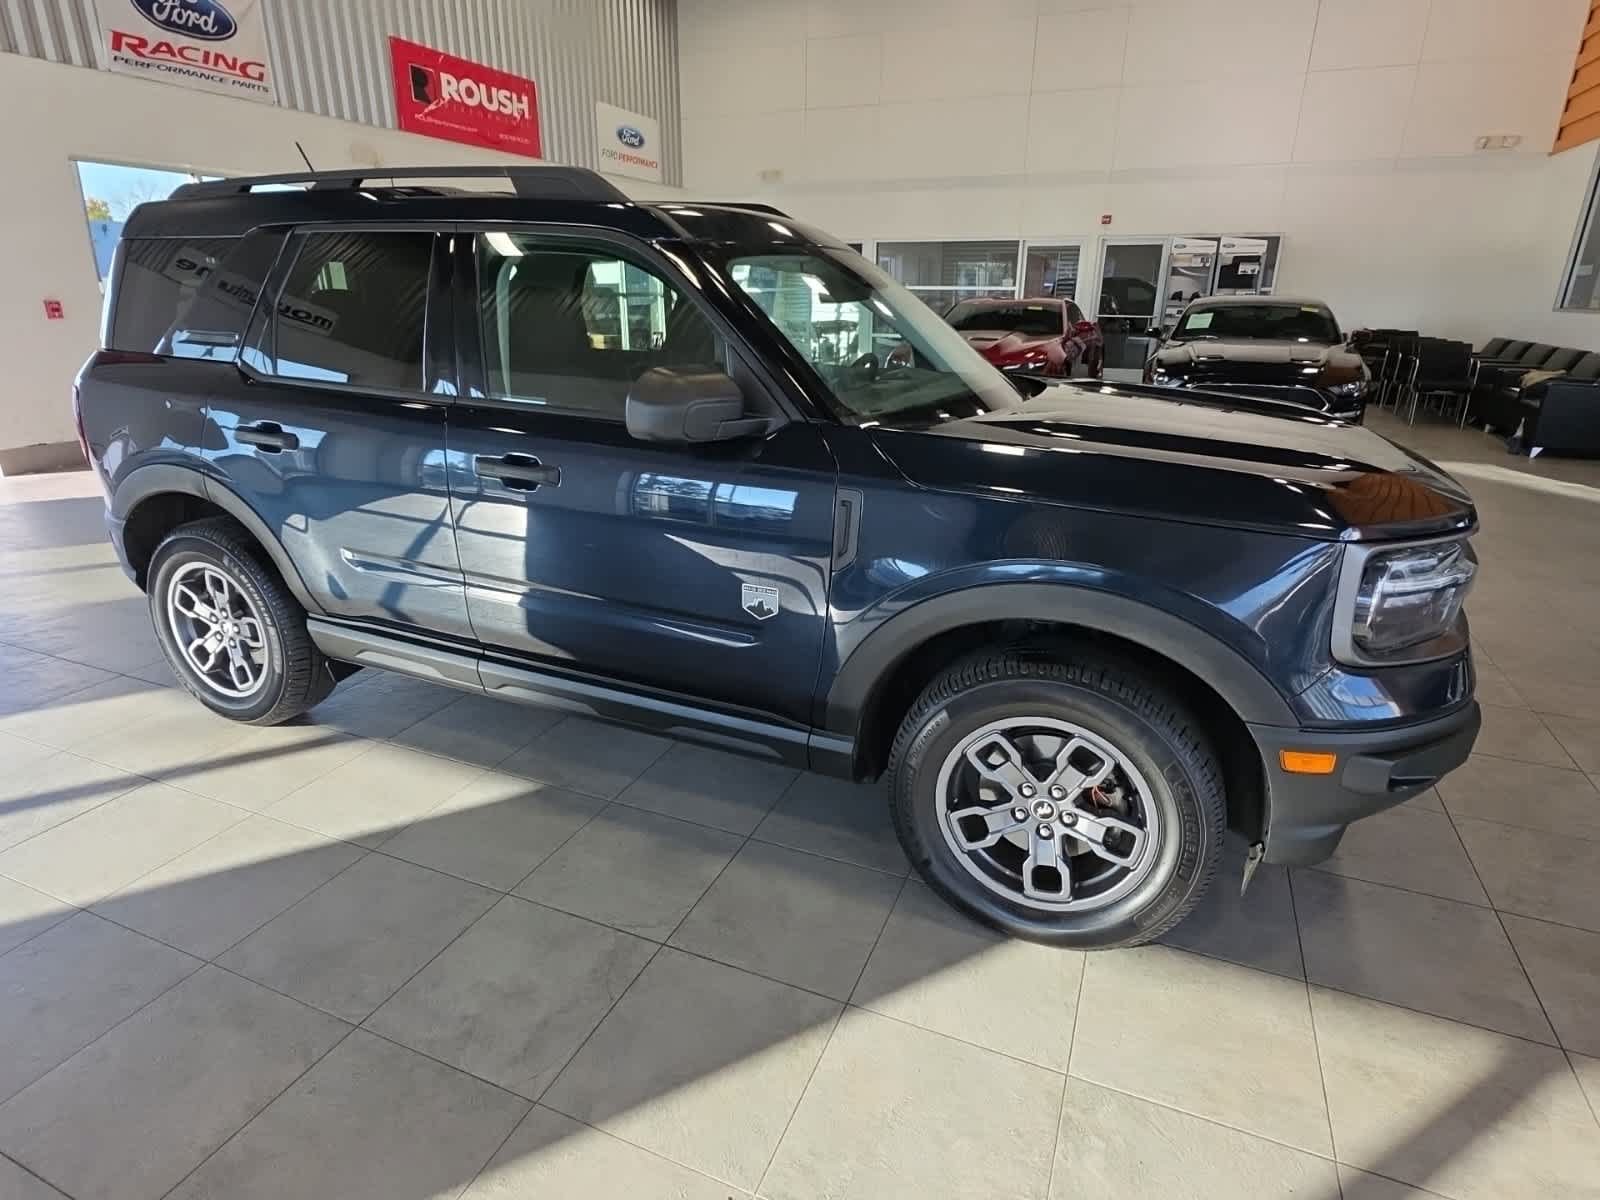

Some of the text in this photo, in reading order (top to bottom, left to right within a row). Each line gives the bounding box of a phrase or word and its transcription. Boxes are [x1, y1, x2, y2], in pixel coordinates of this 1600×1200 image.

[152, 0, 218, 33] Ford
[111, 30, 265, 82] RACING
[113, 55, 270, 93] PERFORMANCE PARTS
[439, 71, 529, 120] ROUSH
[621, 128, 640, 146] Ford
